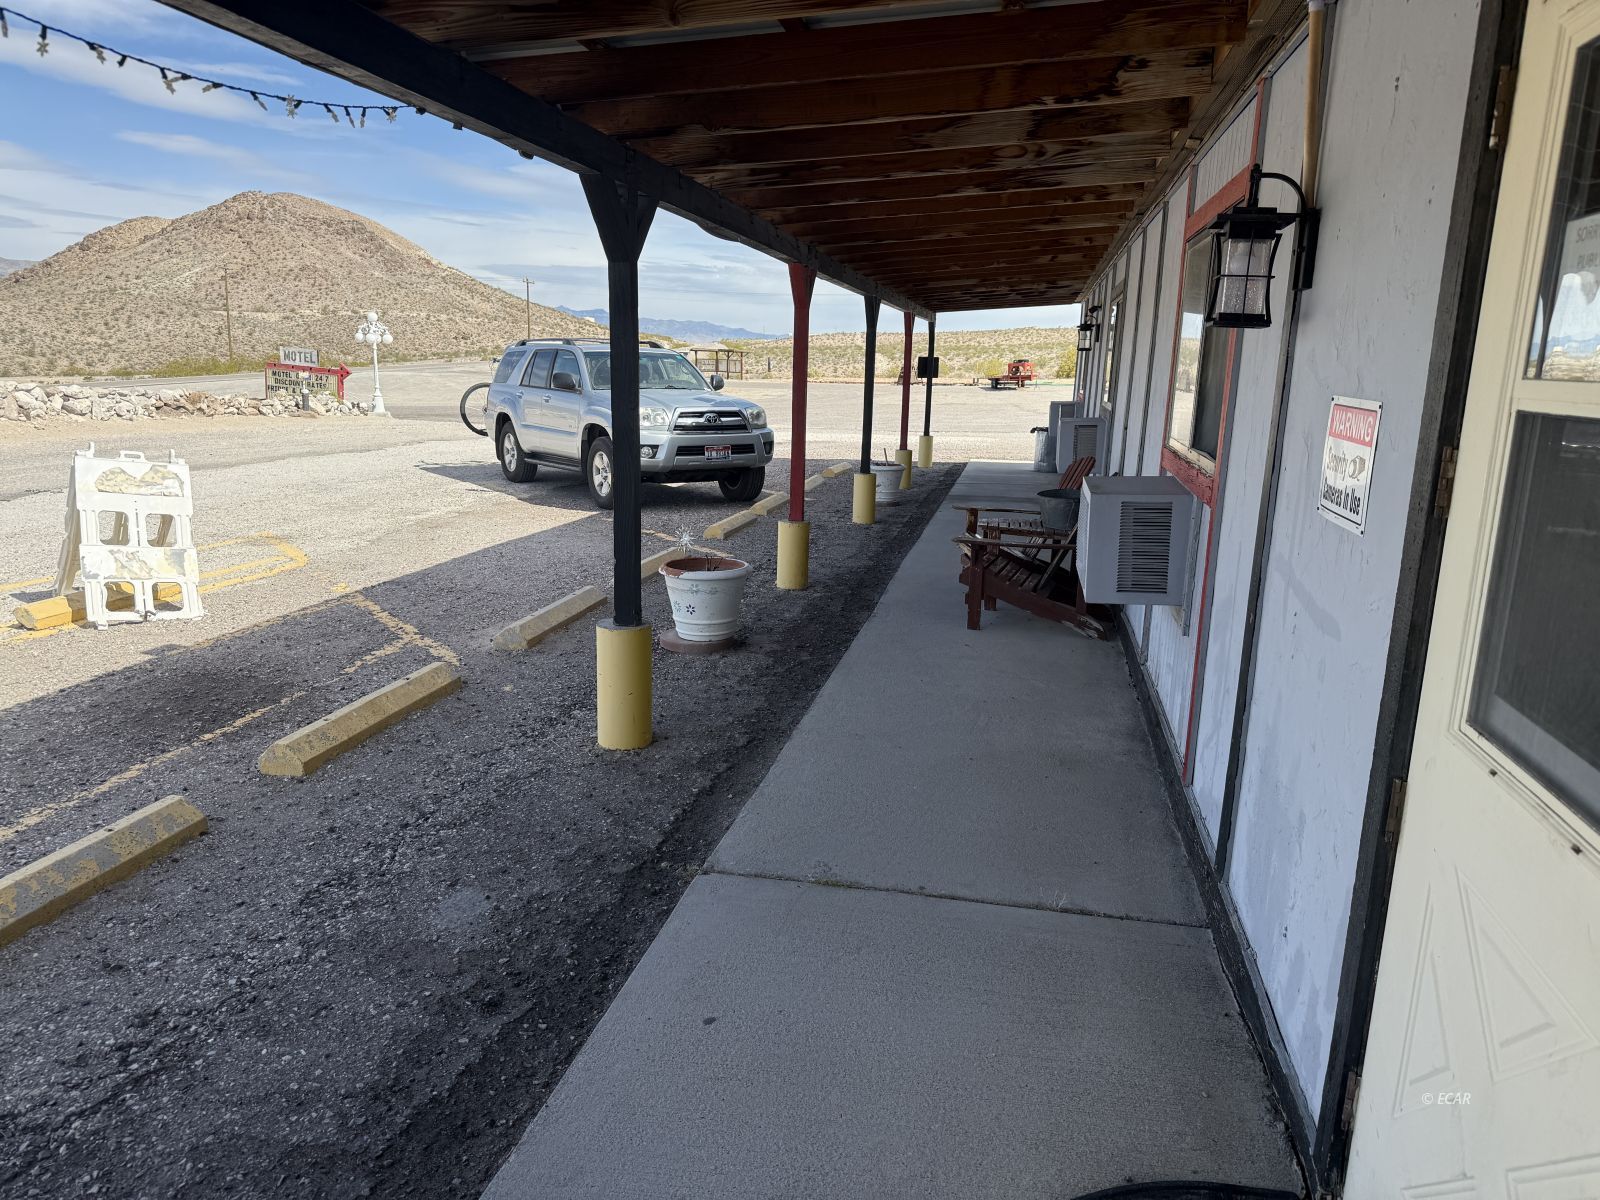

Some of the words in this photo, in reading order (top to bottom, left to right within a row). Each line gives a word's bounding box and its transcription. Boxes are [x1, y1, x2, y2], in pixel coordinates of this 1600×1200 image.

[283, 349, 316, 364] MOTEL
[272, 370, 292, 379] MOTEL
[275, 378, 304, 388] DISCOUNT
[307, 381, 327, 389] RATES
[1332, 409, 1373, 442] WARNING
[1327, 445, 1349, 481] Security
[1323, 476, 1343, 508] Cameras
[1350, 488, 1361, 516] Use
